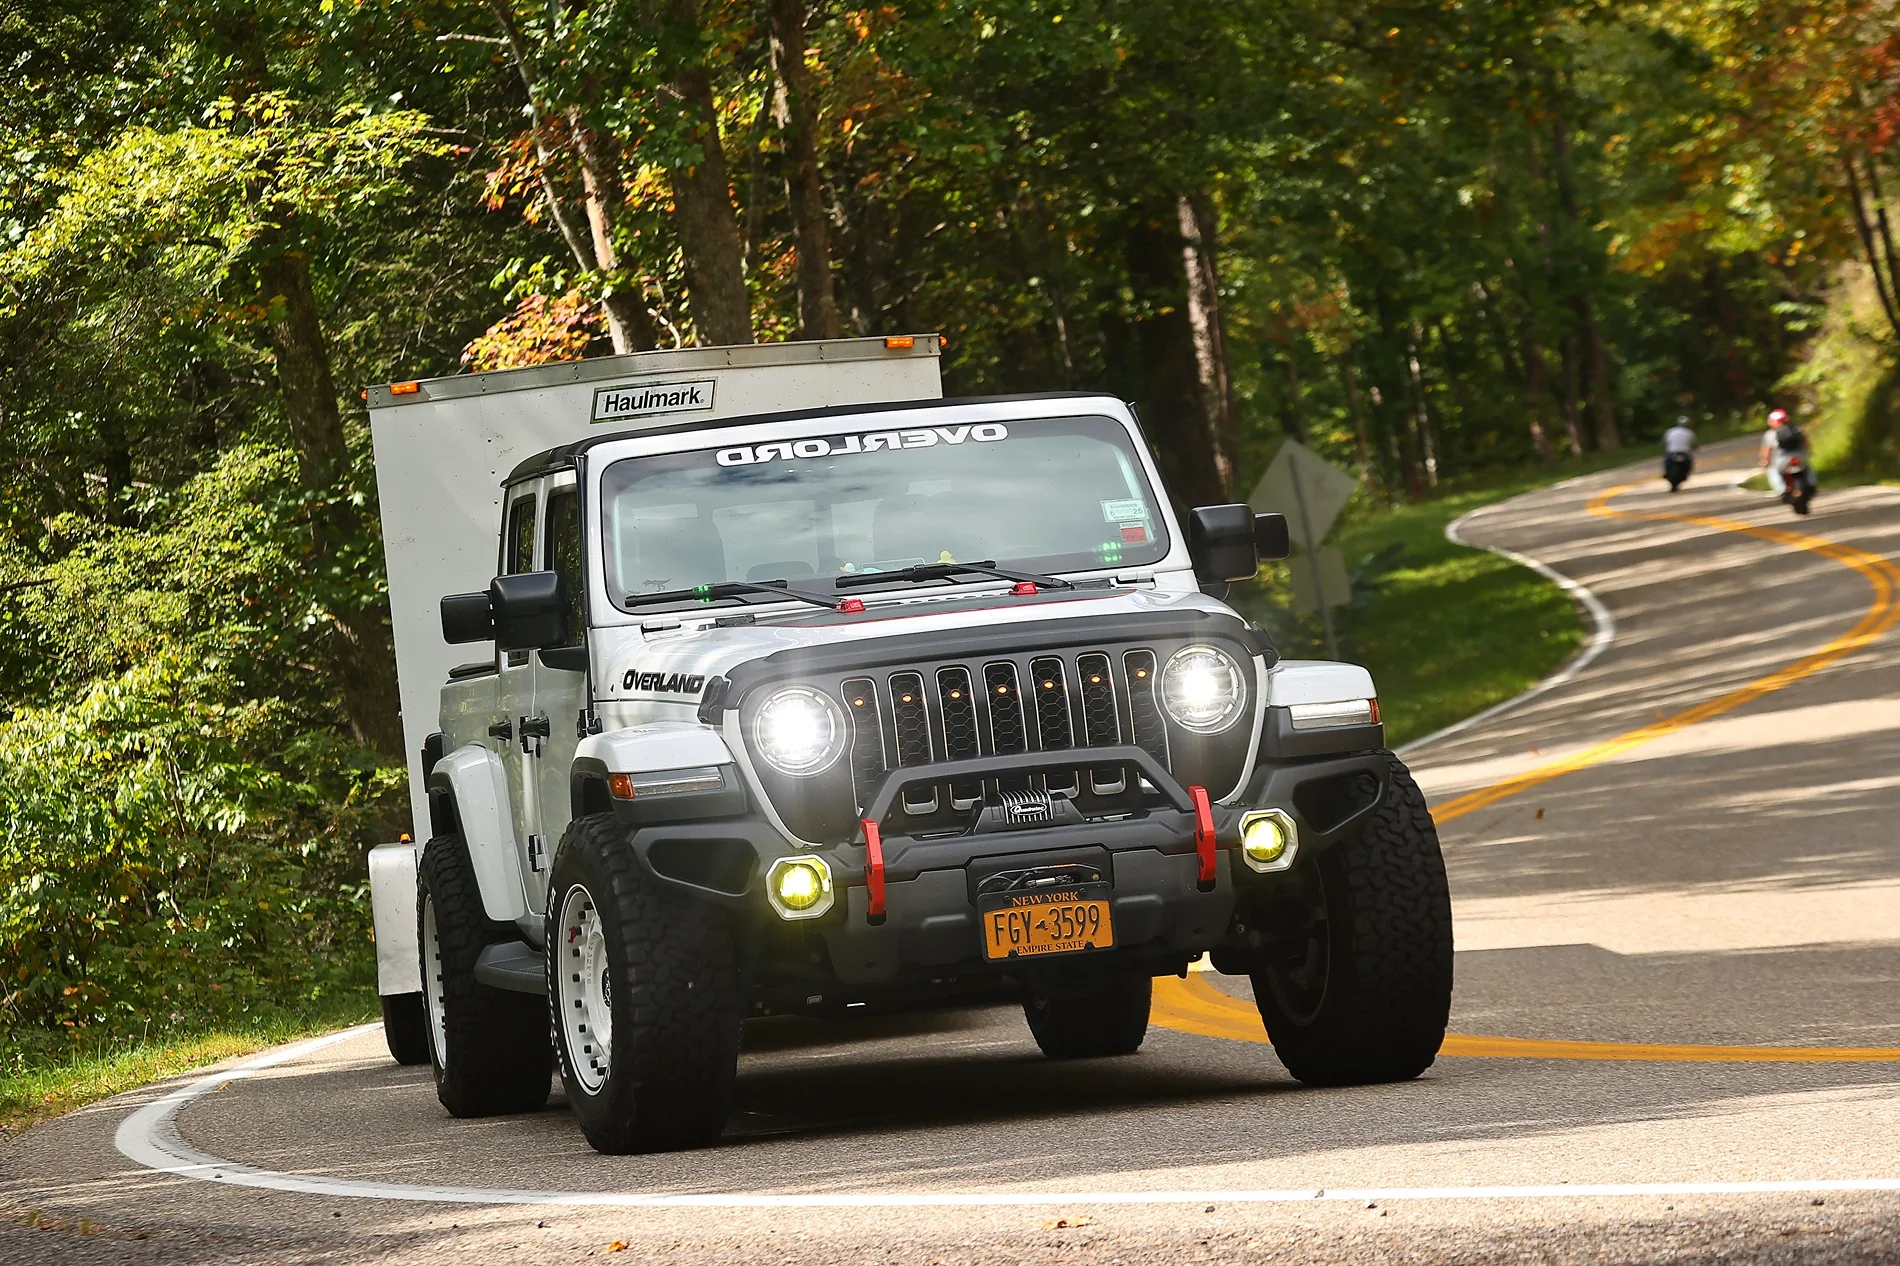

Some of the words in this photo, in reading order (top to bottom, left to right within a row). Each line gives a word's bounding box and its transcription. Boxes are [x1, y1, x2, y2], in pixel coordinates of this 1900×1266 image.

[604, 386, 701, 413] Haulmark
[623, 669, 705, 694] OVERLAND
[1012, 894, 1043, 907] NEW
[1046, 891, 1079, 903] YORK
[993, 909, 1032, 947] FGY
[1048, 903, 1100, 940] 3599
[1017, 943, 1054, 954] EMPIRE
[1055, 939, 1084, 950] STATE
